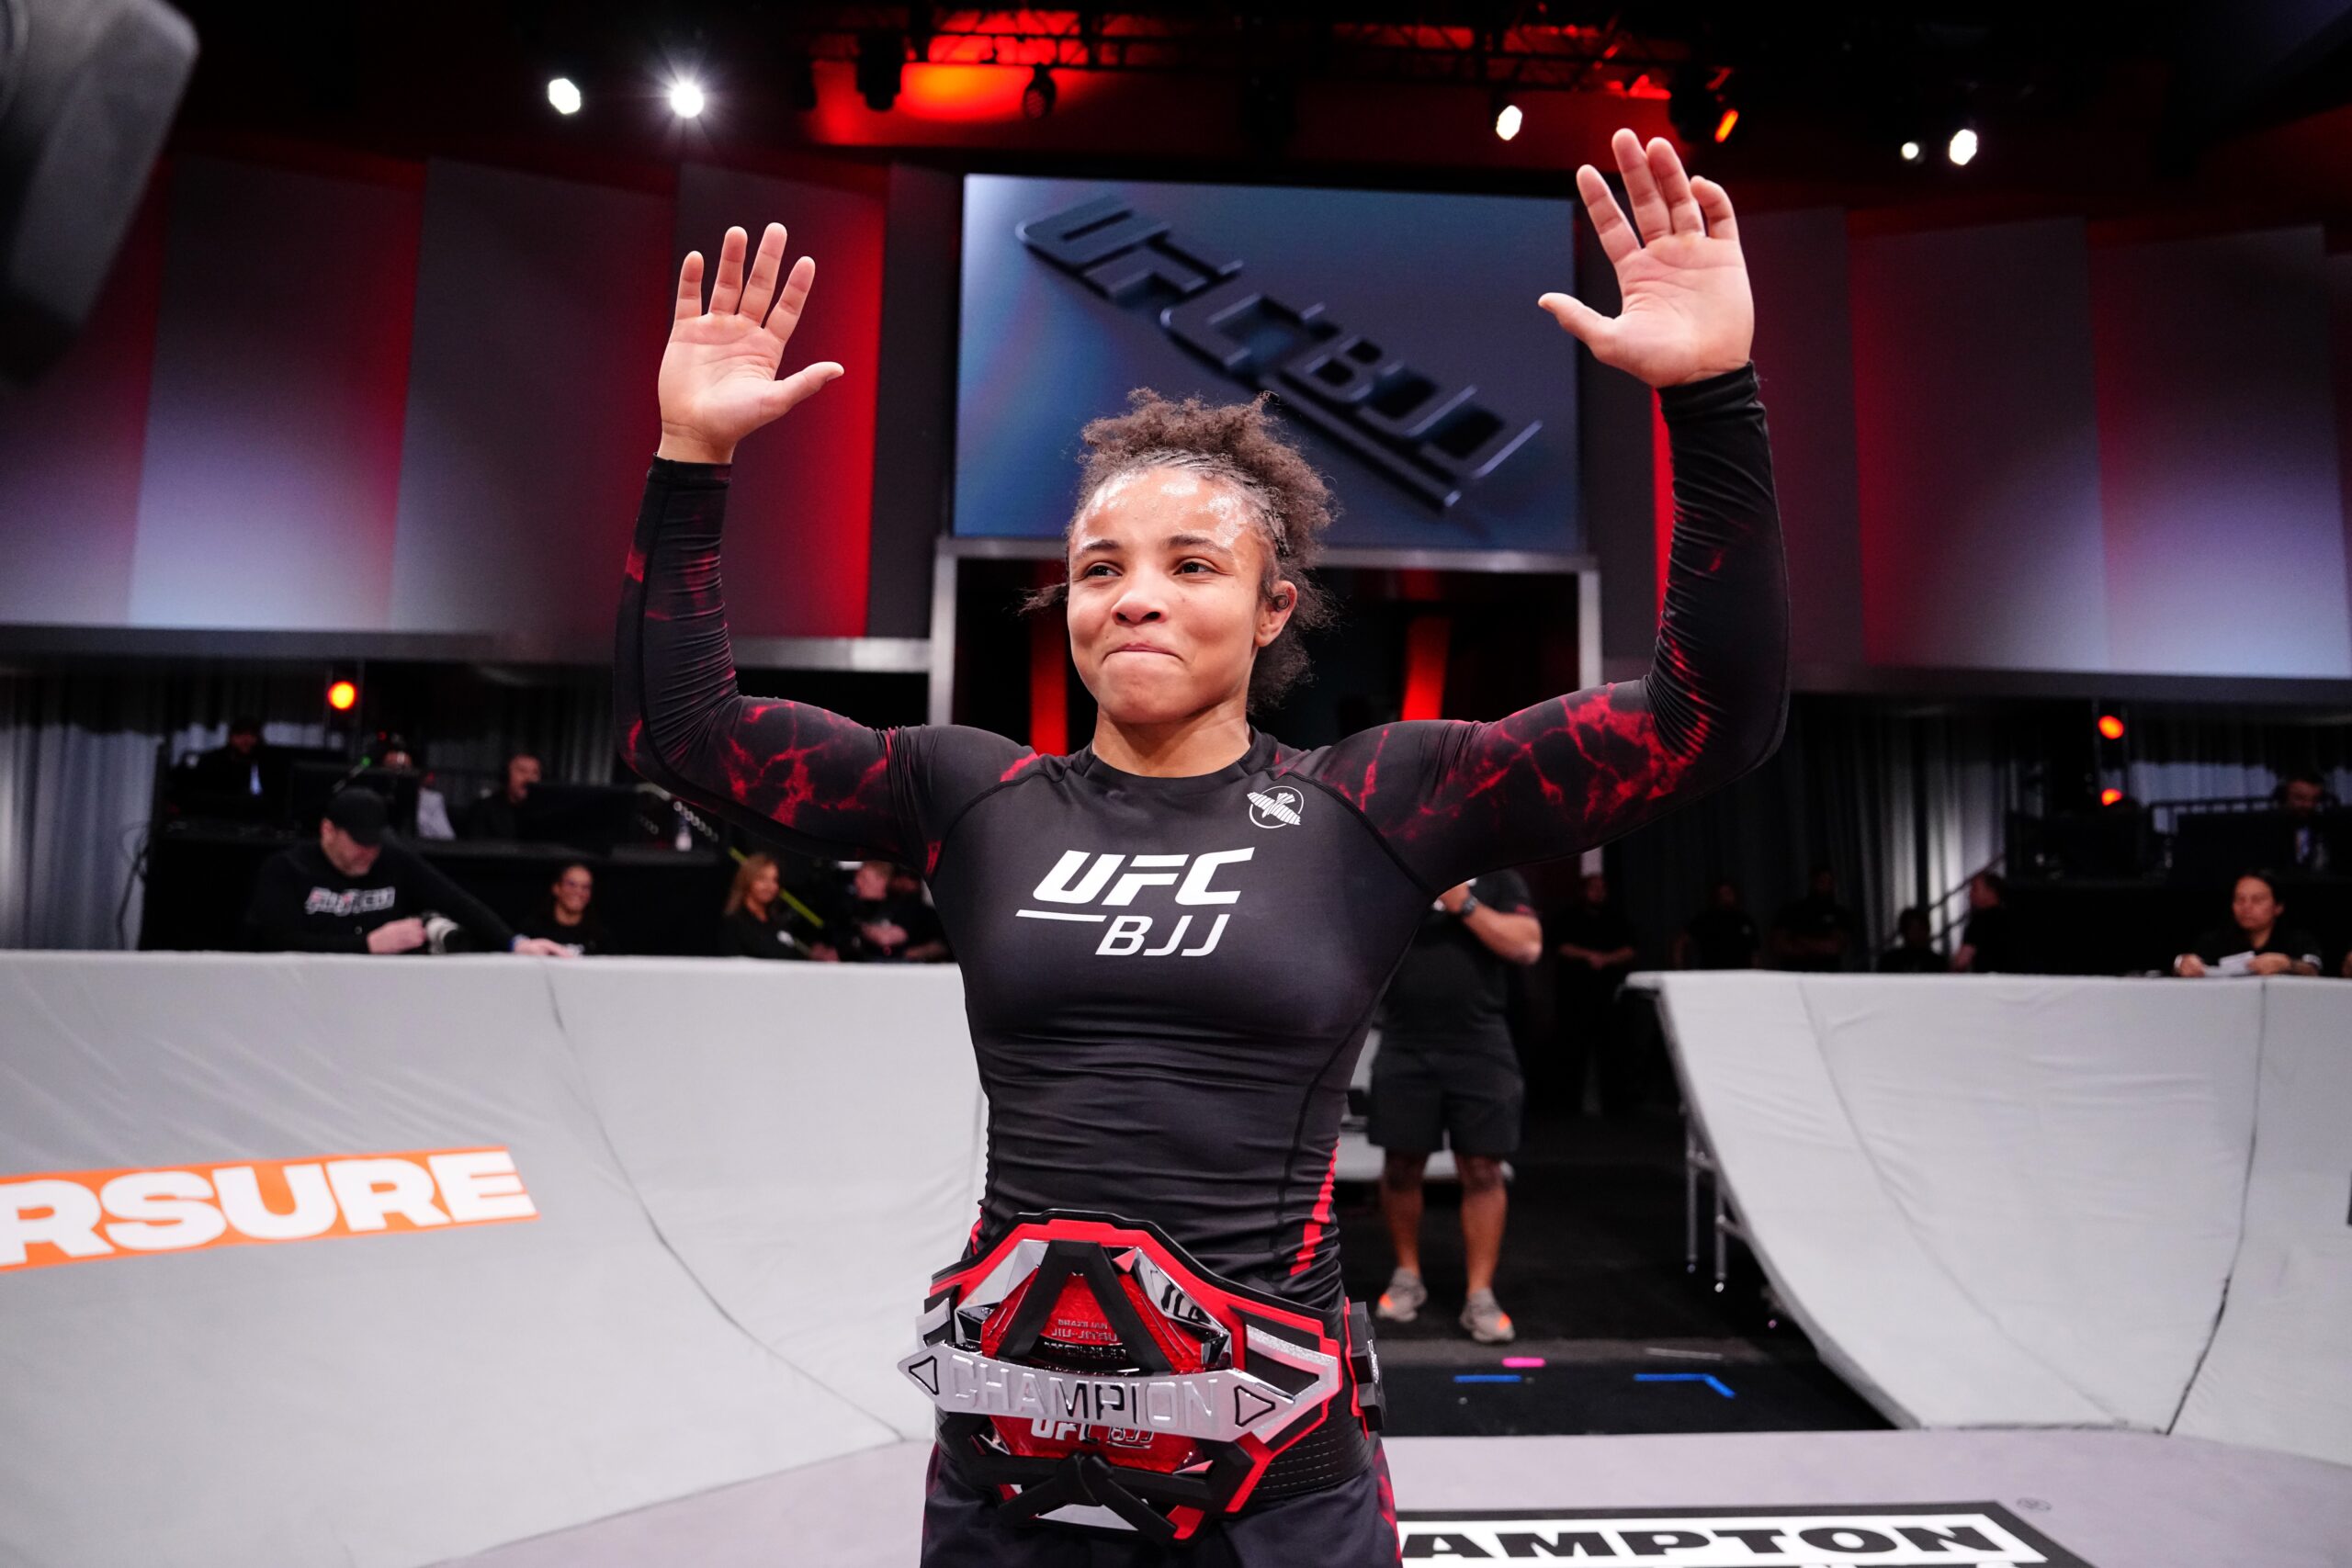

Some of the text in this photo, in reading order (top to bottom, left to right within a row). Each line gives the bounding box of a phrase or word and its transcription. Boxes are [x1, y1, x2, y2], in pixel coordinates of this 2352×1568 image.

[1014, 195, 1544, 482] UFC BJJ
[1033, 847, 1255, 906] UFC
[1095, 914, 1230, 956] BJJ
[0, 1151, 537, 1266] RSURE
[1051, 1327, 1118, 1342] JIU-JITSU
[948, 1353, 1218, 1429] CHAMPION
